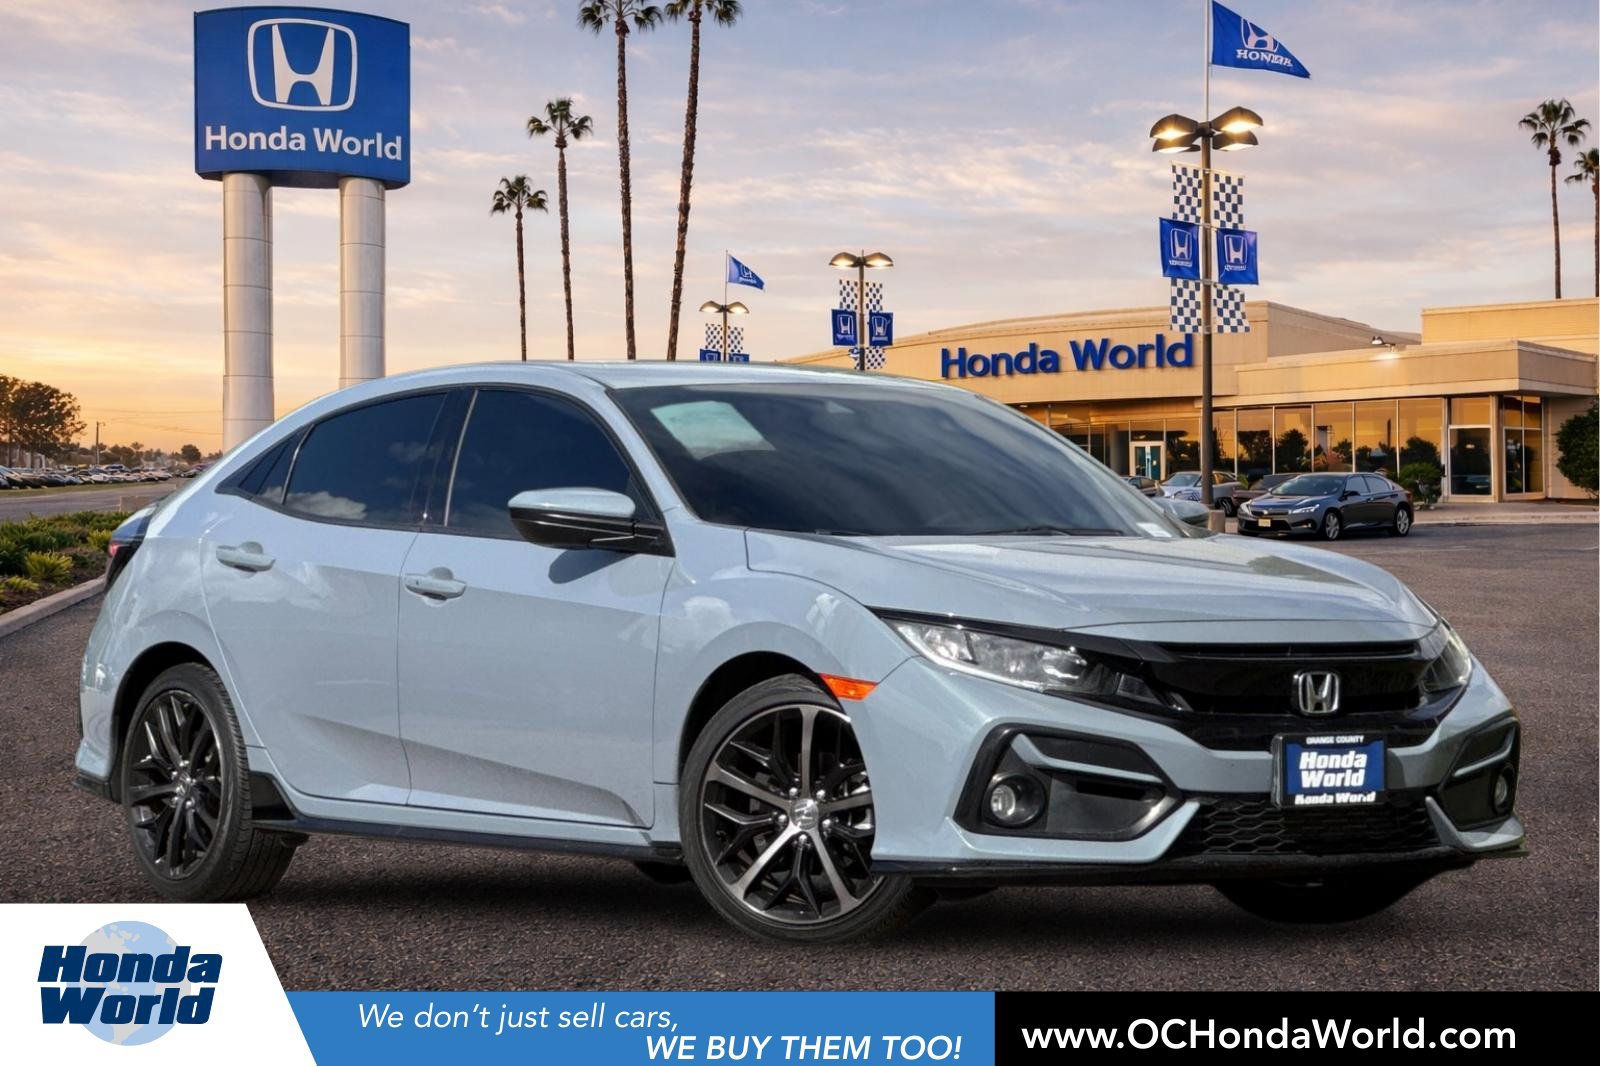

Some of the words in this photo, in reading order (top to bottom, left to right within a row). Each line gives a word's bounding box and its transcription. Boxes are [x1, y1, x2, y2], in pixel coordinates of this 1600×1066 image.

[205, 125, 306, 151] Honda
[313, 127, 402, 160] World
[941, 342, 1060, 377] Honda
[1070, 333, 1194, 370] World
[1305, 735, 1335, 745] ORANGE
[1335, 735, 1365, 744] COUNTY
[1299, 750, 1368, 769] Honda
[1301, 769, 1366, 788] World
